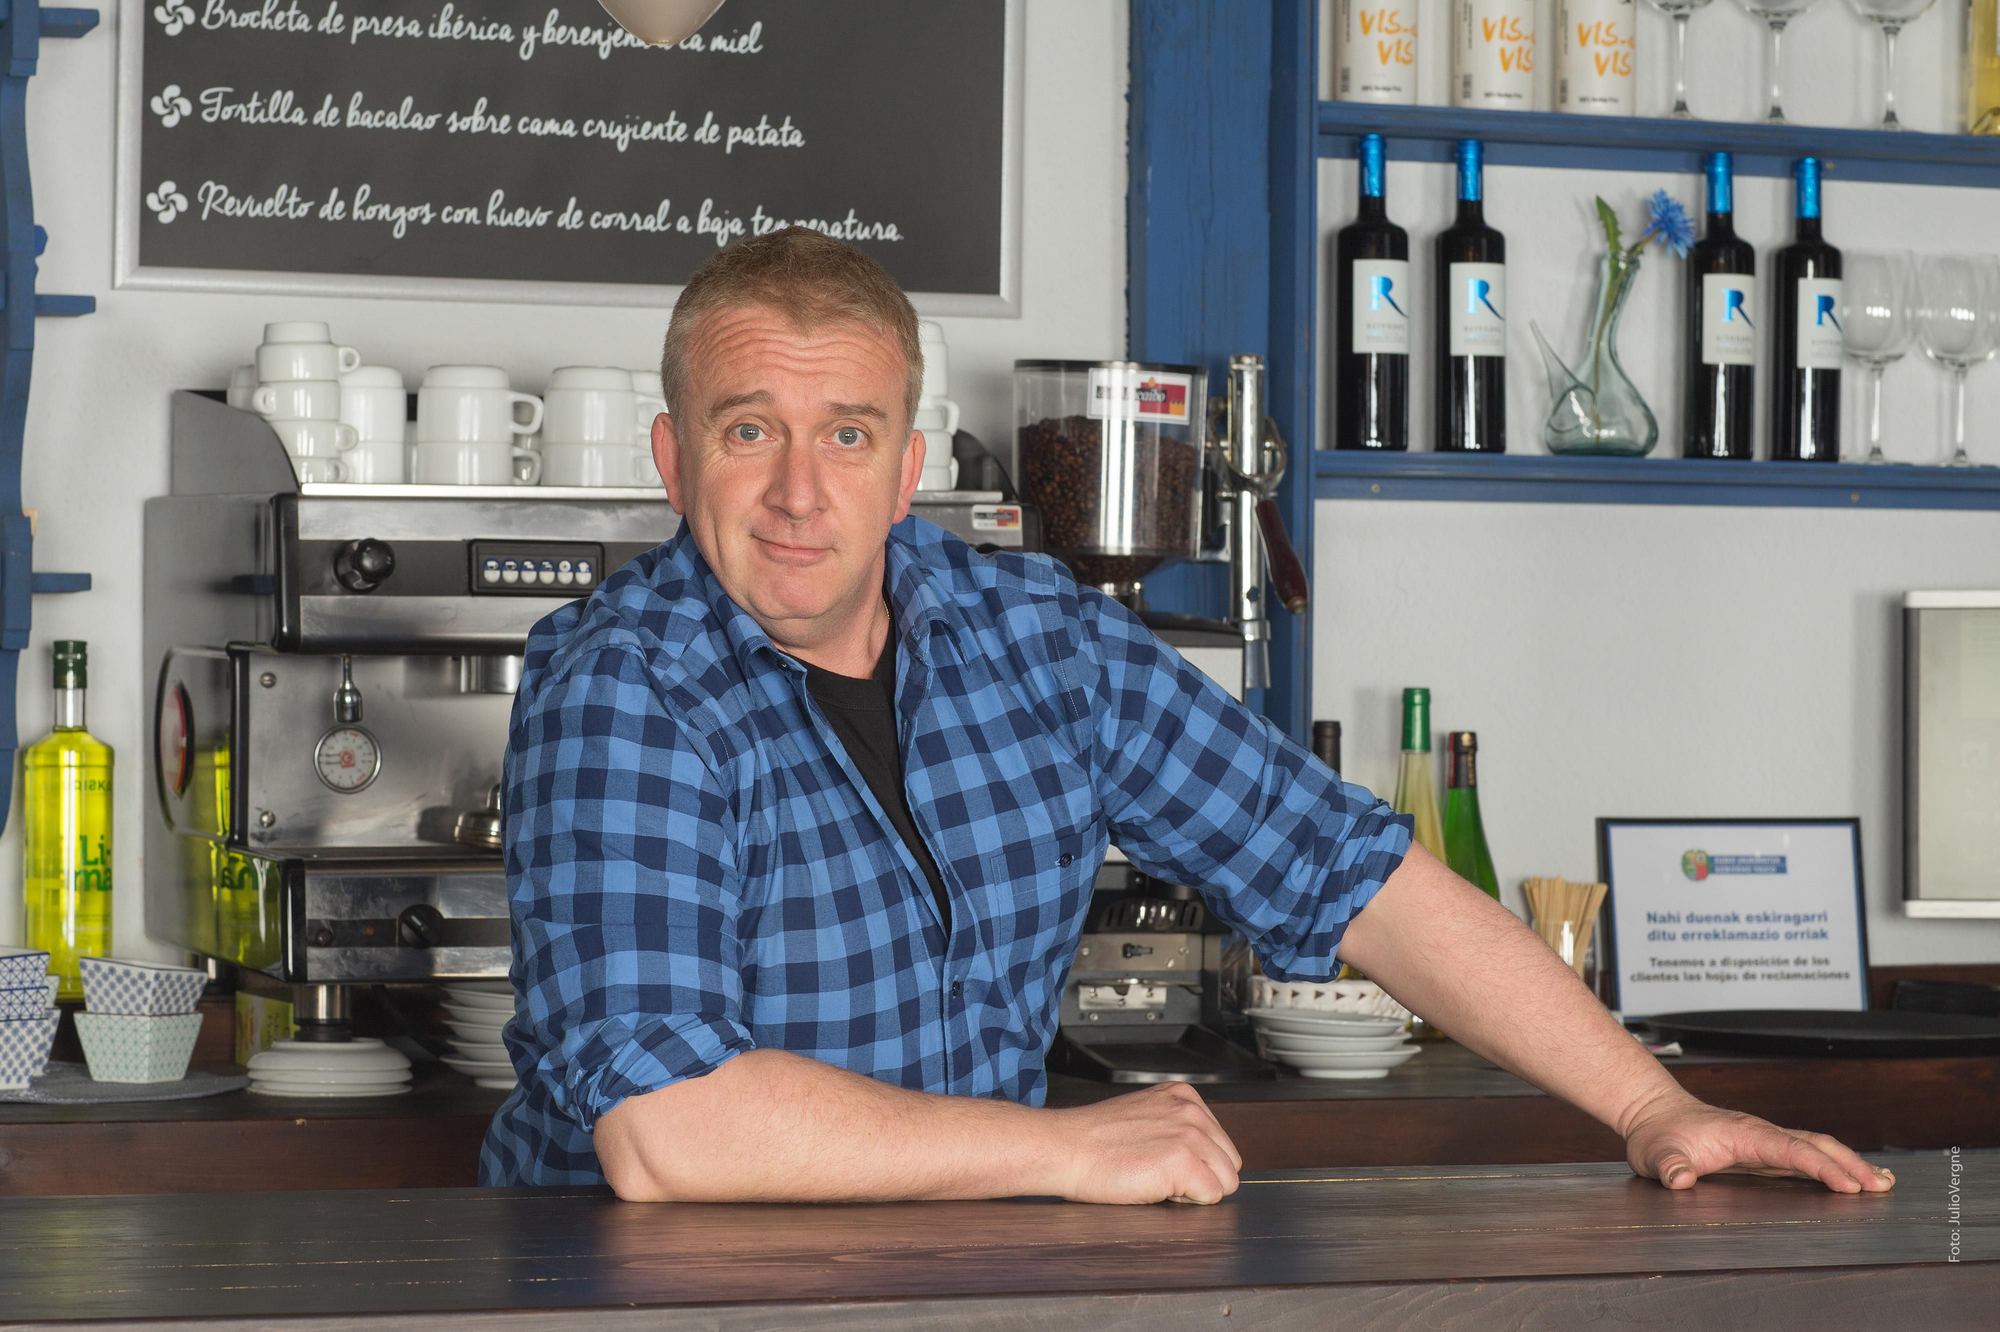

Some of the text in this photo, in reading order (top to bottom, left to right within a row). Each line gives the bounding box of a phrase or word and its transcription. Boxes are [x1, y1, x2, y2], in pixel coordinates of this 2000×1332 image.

[201, 0, 313, 33] Brocheta
[317, 1, 346, 35] de
[351, 15, 423, 45] presa
[428, 3, 515, 43] ibérica
[519, 25, 542, 61] y
[679, 33, 706, 52] a
[709, 20, 763, 54] miel
[1378, 39, 1414, 66] VIS
[1499, 45, 1534, 73] VIS
[1594, 50, 1632, 77] VIS
[199, 86, 806, 154] Tortilla de bacalao sobre cama crujiente de patata
[197, 180, 315, 221] Revuelto
[318, 187, 347, 222] de
[352, 184, 437, 239] hongos
[440, 205, 482, 225] con
[485, 188, 553, 228] huevo
[556, 196, 584, 230] de
[589, 198, 672, 233] corral
[676, 215, 693, 234] a
[696, 197, 746, 247] baja
[1368, 275, 1409, 319] R
[1465, 278, 1506, 321] R
[1720, 287, 1755, 329] R
[1813, 293, 1843, 334] R
[1646, 910, 1828, 926] Nahi duenak eskiragarri
[1647, 928, 1829, 942] ditu erreklamazio orriak
[1630, 970, 1851, 983] clientes las hojas de reclamaciones
[1649, 956, 1830, 970] Tenemos a disposición de los
